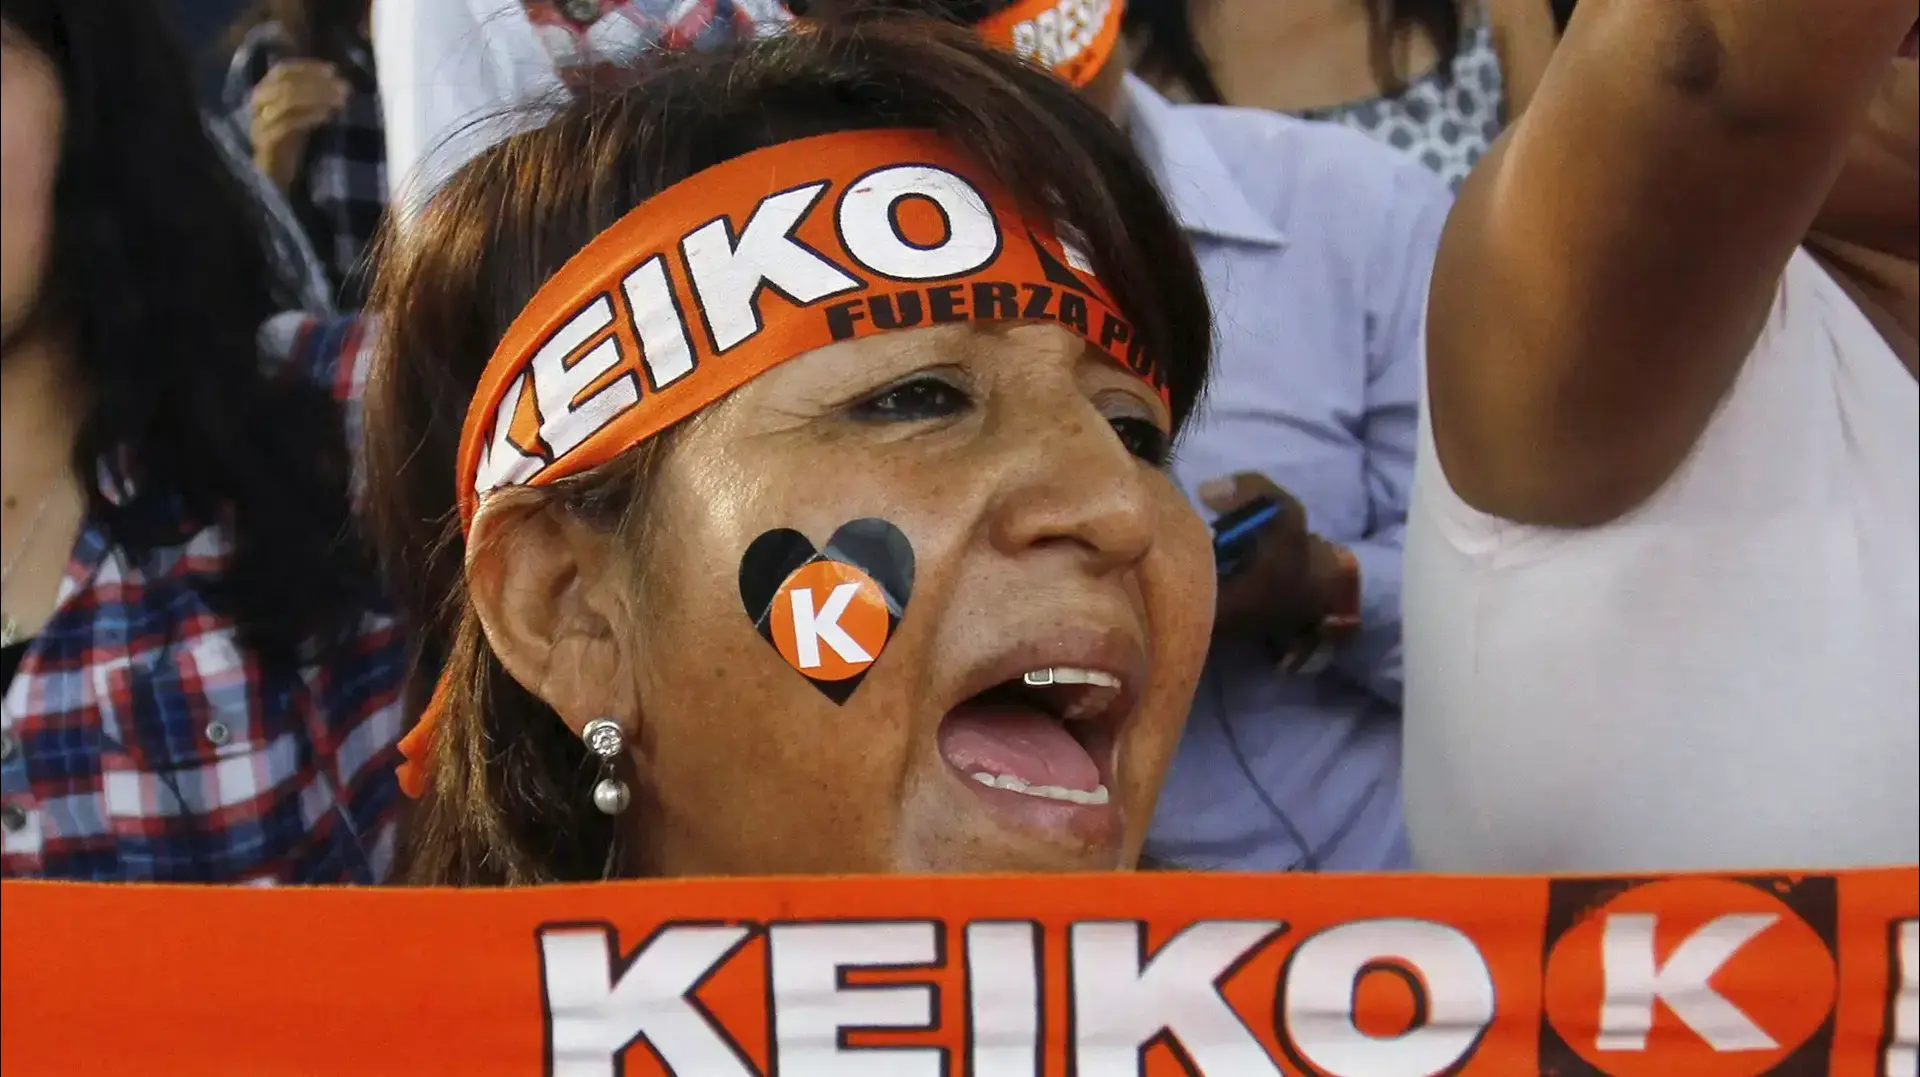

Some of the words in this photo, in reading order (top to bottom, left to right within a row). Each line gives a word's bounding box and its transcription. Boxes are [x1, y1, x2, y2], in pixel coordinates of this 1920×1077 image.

[1012, 0, 1111, 72] PRES
[473, 162, 1003, 499] KEIKO
[824, 281, 1089, 342] FUERZA
[790, 581, 875, 669] K
[535, 917, 1496, 1077] KEIKO
[1595, 912, 1782, 1052] K
